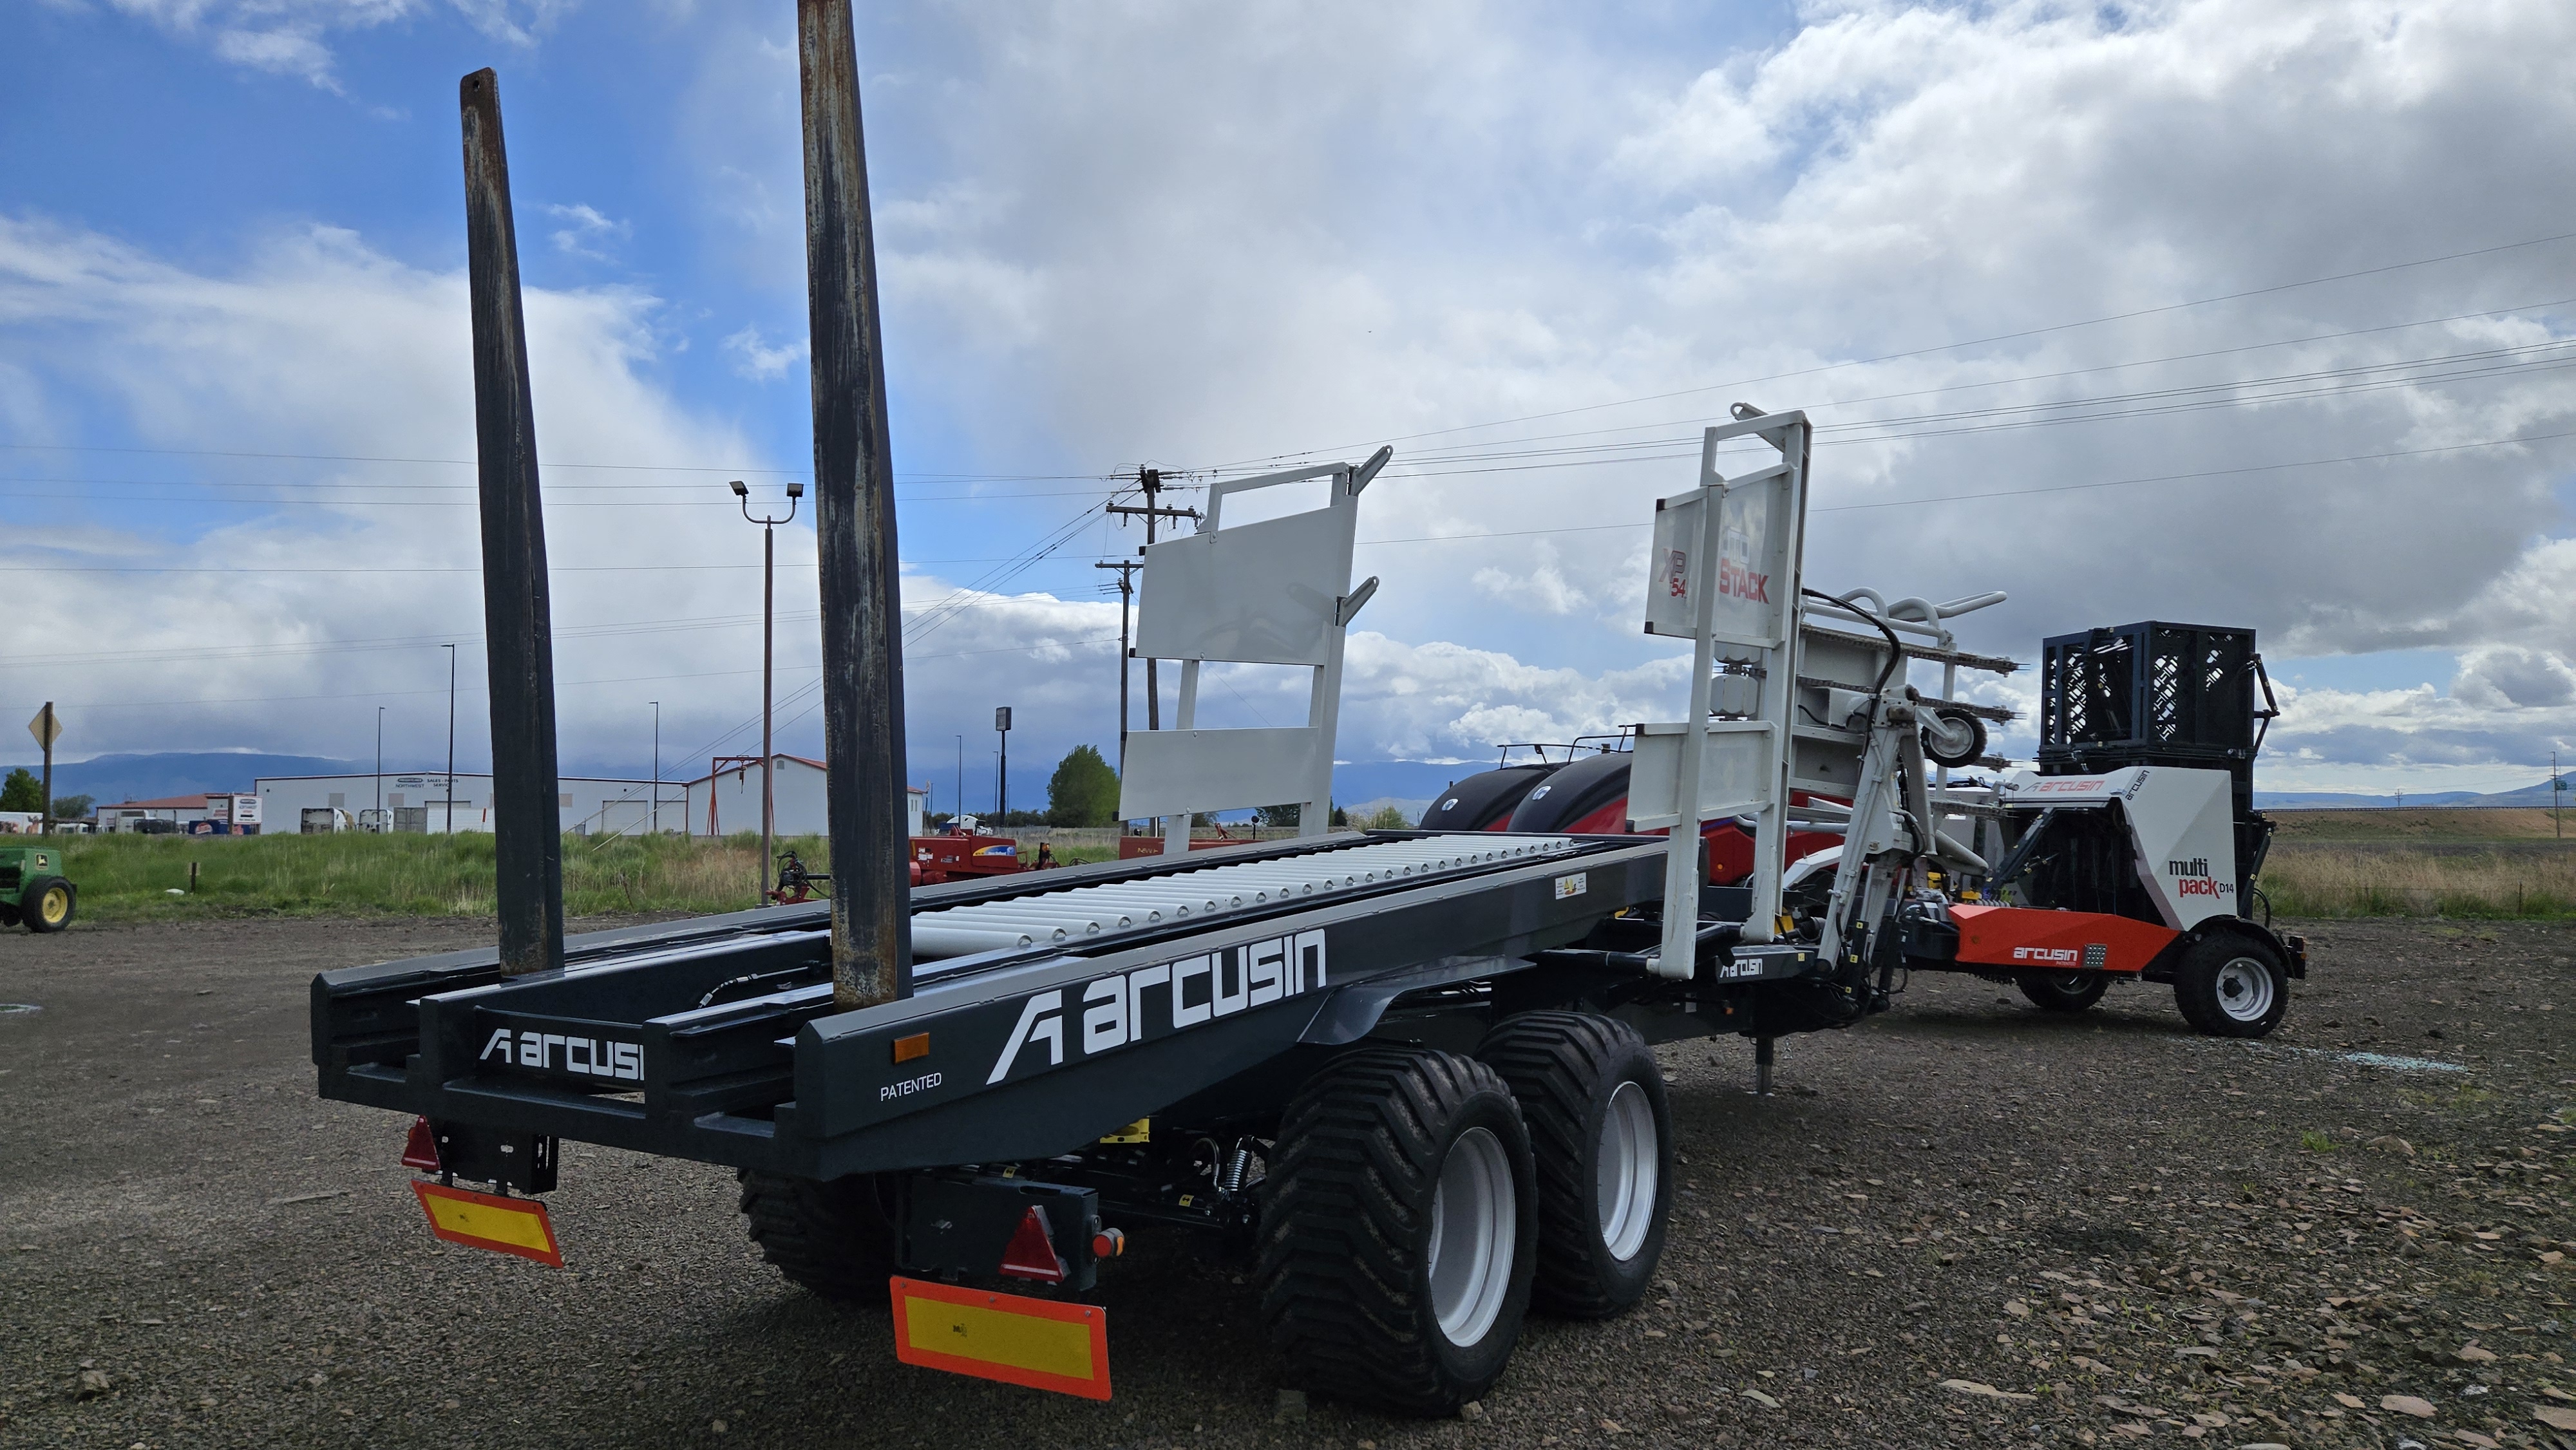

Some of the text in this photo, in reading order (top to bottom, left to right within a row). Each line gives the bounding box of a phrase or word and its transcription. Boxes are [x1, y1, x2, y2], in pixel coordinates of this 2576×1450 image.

[1658, 549, 1687, 583] XP
[1671, 578, 1687, 598] 54
[1719, 558, 1770, 605] STACK
[2169, 858, 2208, 876] multi
[2179, 876, 2234, 899] pack D14
[880, 1072, 942, 1102] PATENTED
